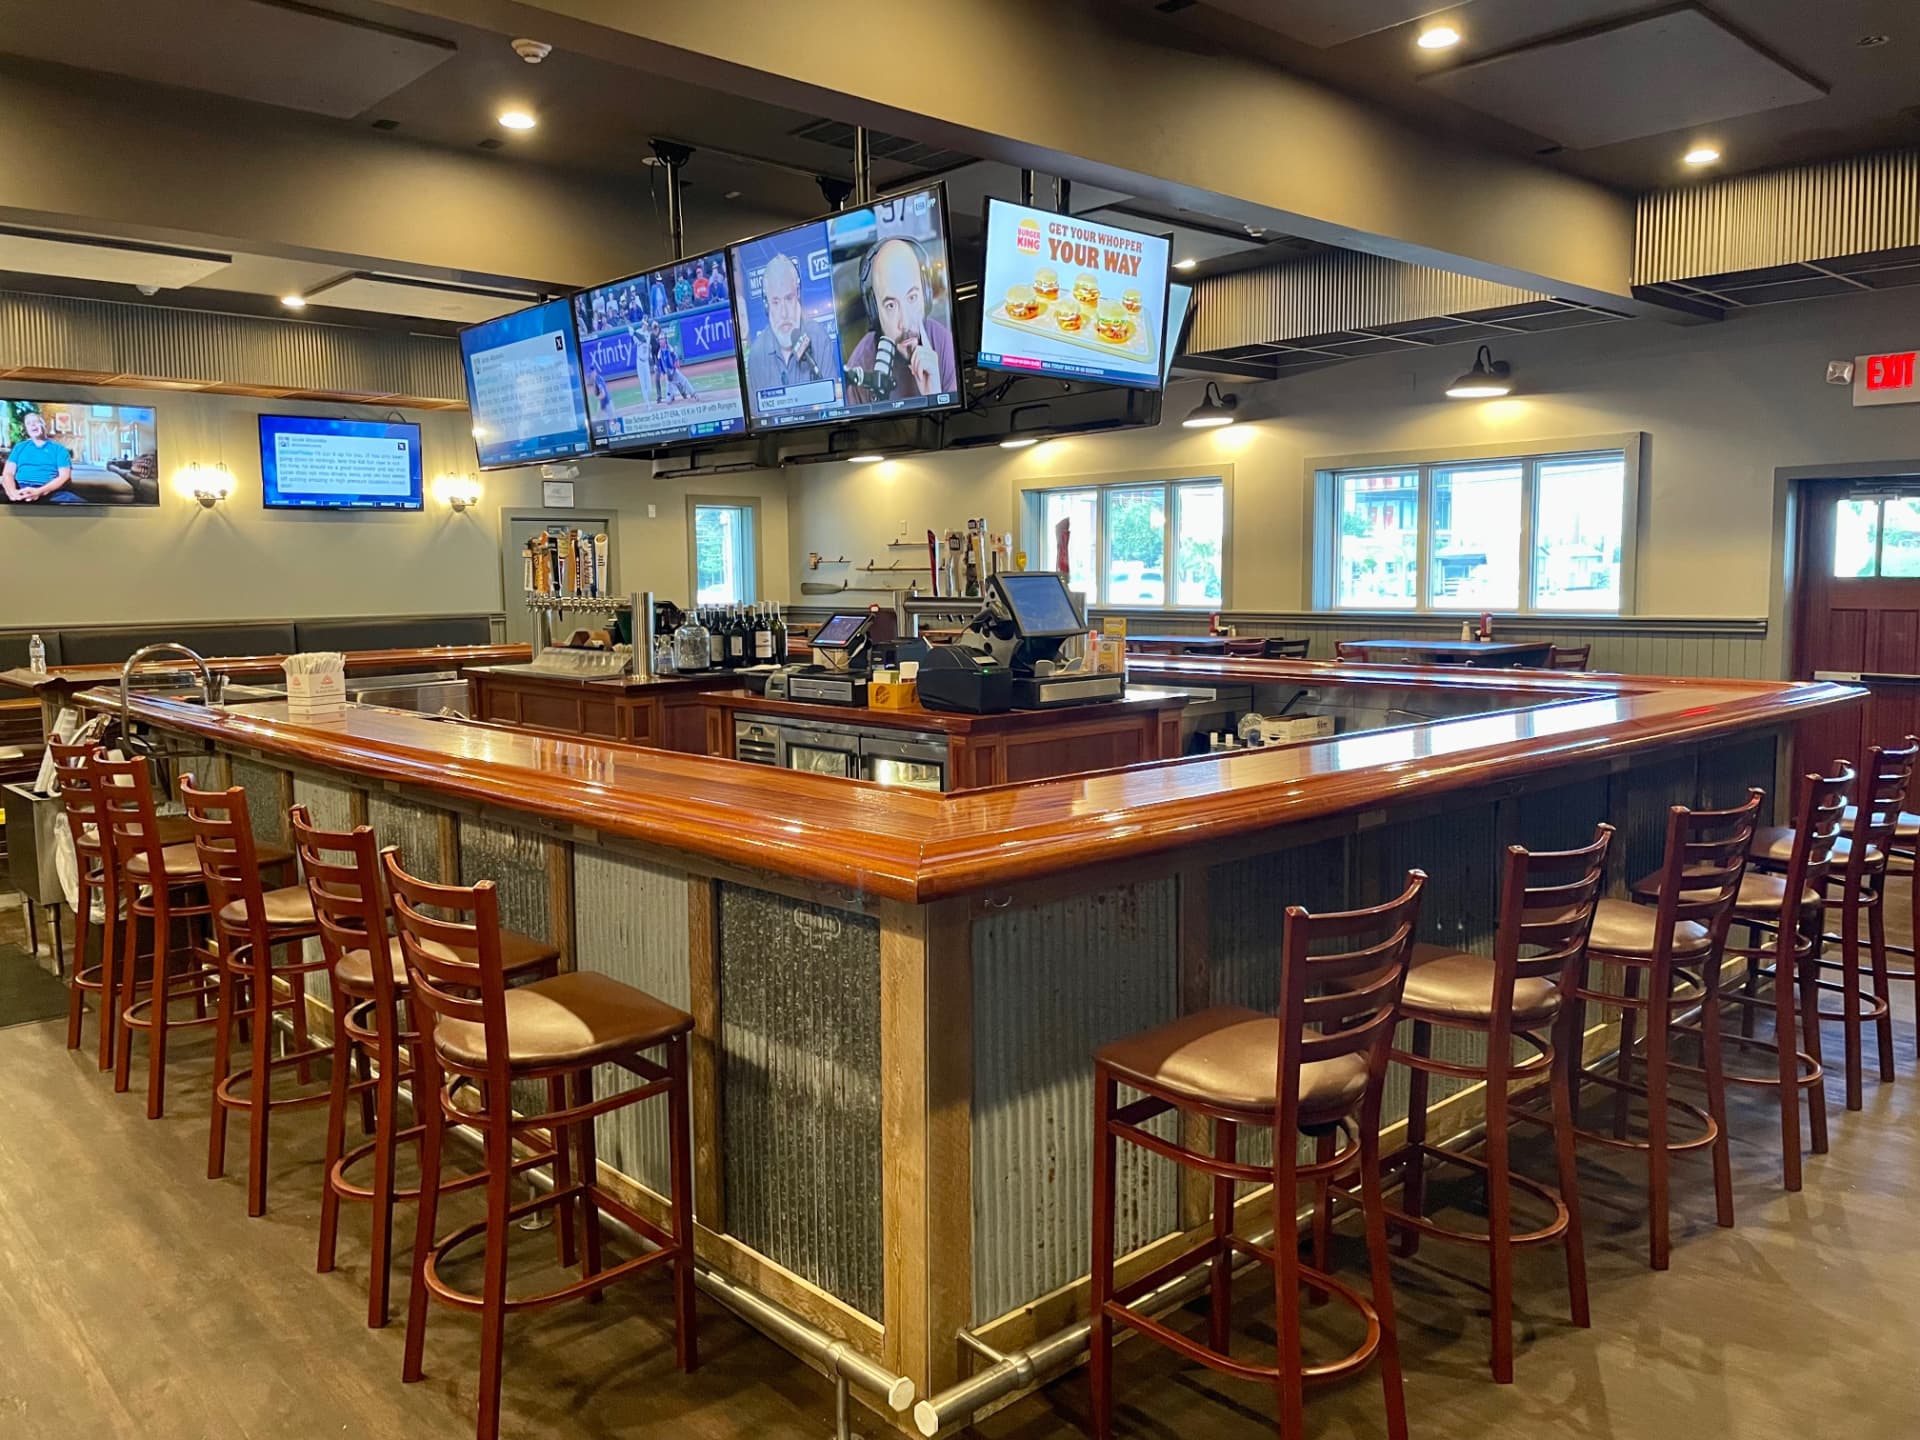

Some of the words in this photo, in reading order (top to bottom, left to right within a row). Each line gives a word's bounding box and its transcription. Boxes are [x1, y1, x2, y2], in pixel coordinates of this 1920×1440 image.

[1016, 236, 1041, 251] KING
[1017, 227, 1041, 240] BURGER
[1048, 222, 1069, 237] GET
[1070, 226, 1096, 241] YOUR
[1097, 232, 1142, 254] WHOPPER
[1048, 237, 1099, 270] YOUR
[1103, 249, 1142, 277] WAY
[694, 315, 733, 351] xfini
[589, 340, 633, 373] xfinity
[1867, 352, 1915, 391] EXIT
